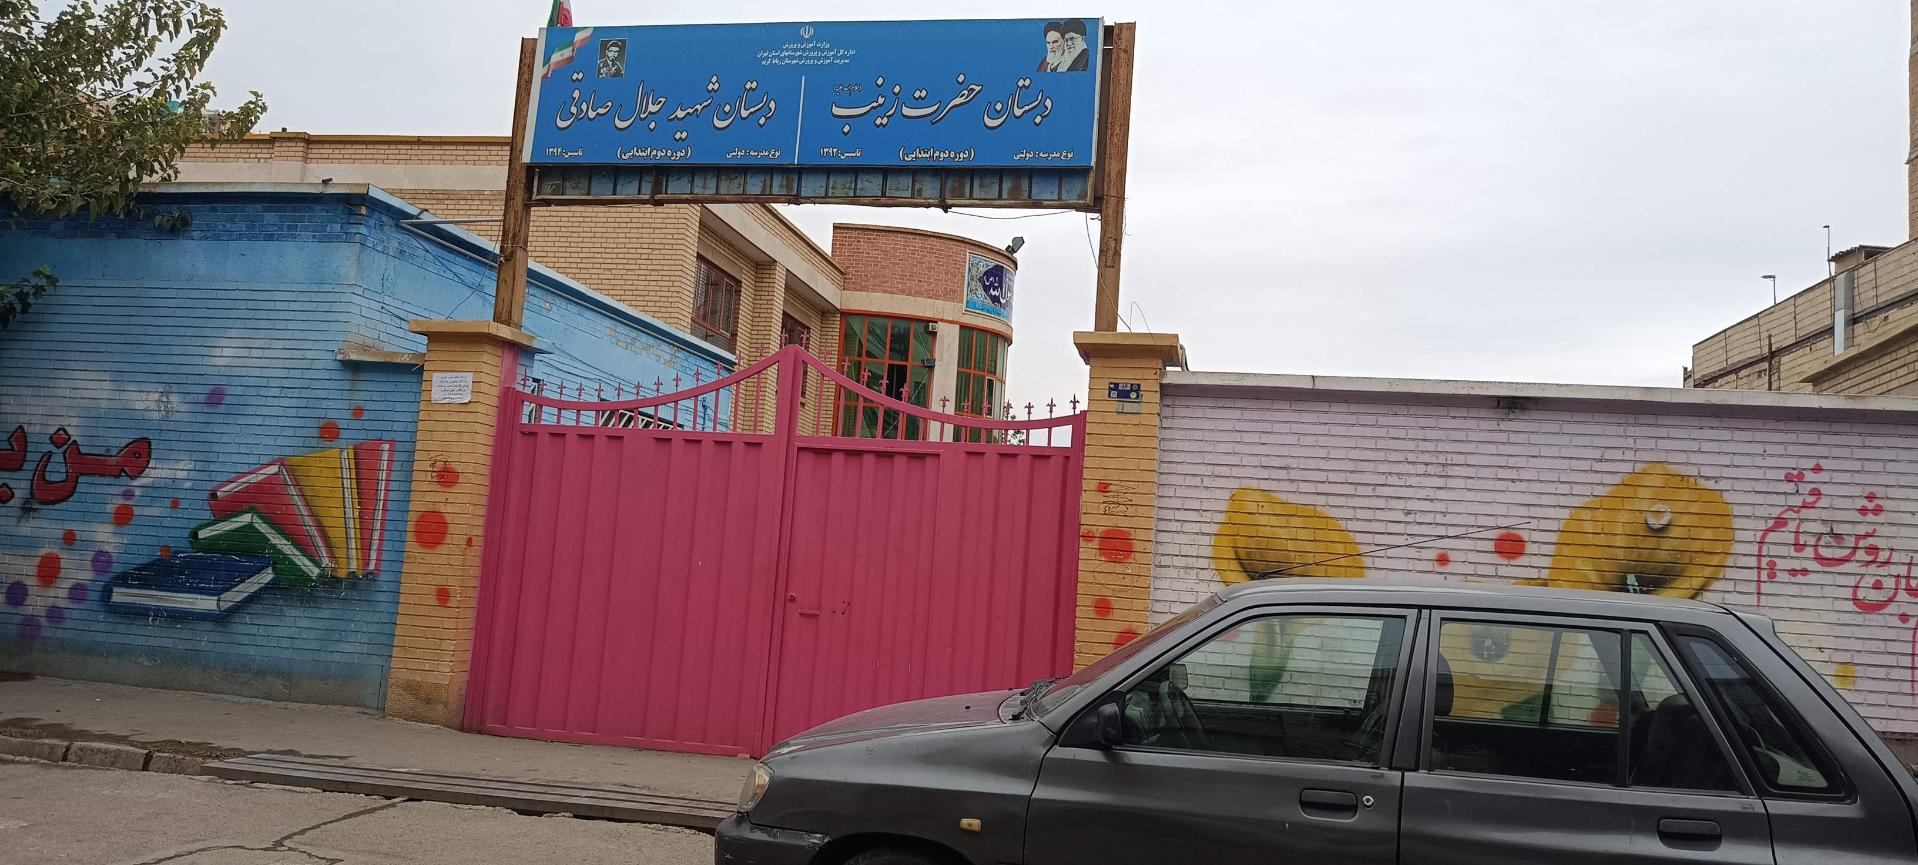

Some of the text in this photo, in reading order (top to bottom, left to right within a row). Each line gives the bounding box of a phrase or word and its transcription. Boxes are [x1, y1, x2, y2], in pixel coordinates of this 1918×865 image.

[801, 41, 816, 49] آموزش
[817, 41, 830, 49] وزارت
[555, 71, 777, 141] دبستان شهید جلال صادقی
[831, 72, 1053, 135] دبستان حضرت زینب
[650, 148, 667, 160] دوم
[726, 147, 745, 159] دولتی
[769, 147, 781, 158] نوع
[933, 149, 950, 161] دوم
[1013, 149, 1034, 160] دولتی
[1060, 149, 1074, 159] نوع
[31, 426, 152, 505] من
[1813, 491, 1894, 569] روشن
